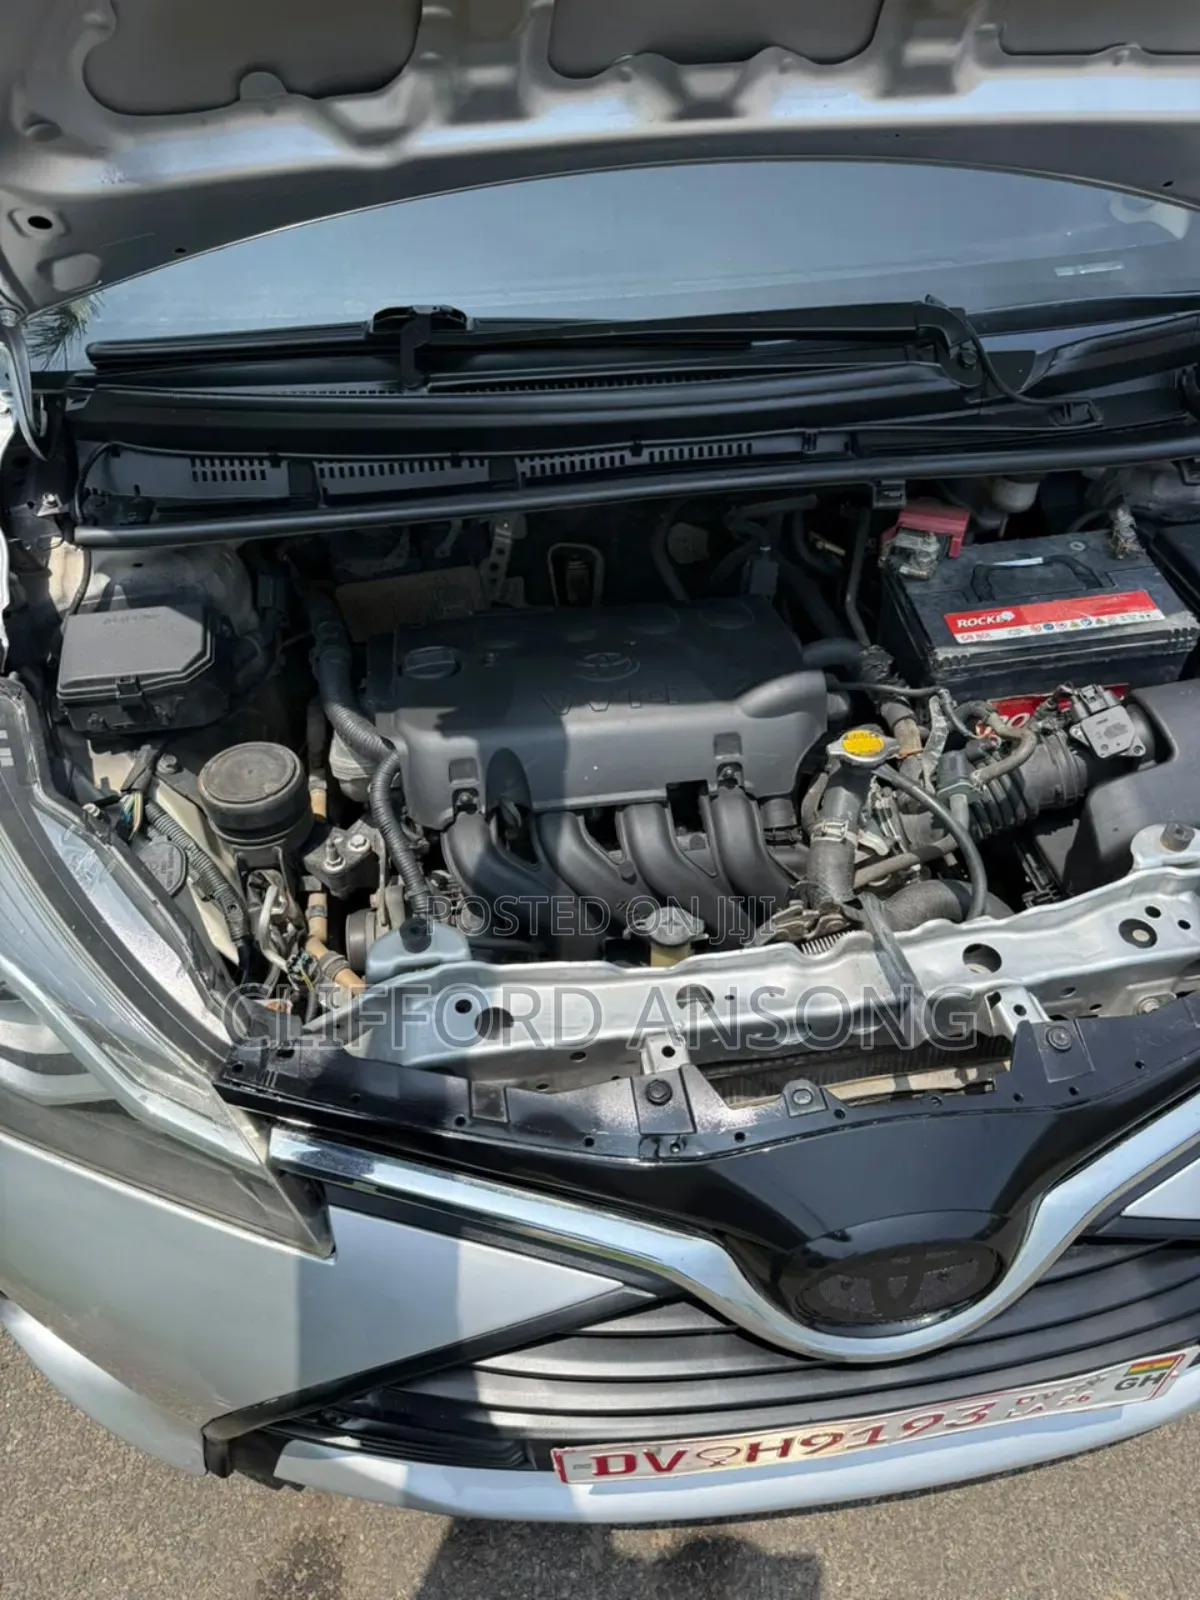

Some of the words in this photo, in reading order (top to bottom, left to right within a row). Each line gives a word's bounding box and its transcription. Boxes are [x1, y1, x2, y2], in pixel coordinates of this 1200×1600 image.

[1114, 1371, 1167, 1391] GH
[590, 1449, 688, 1477] DV
[745, 1401, 996, 1463] H9193
